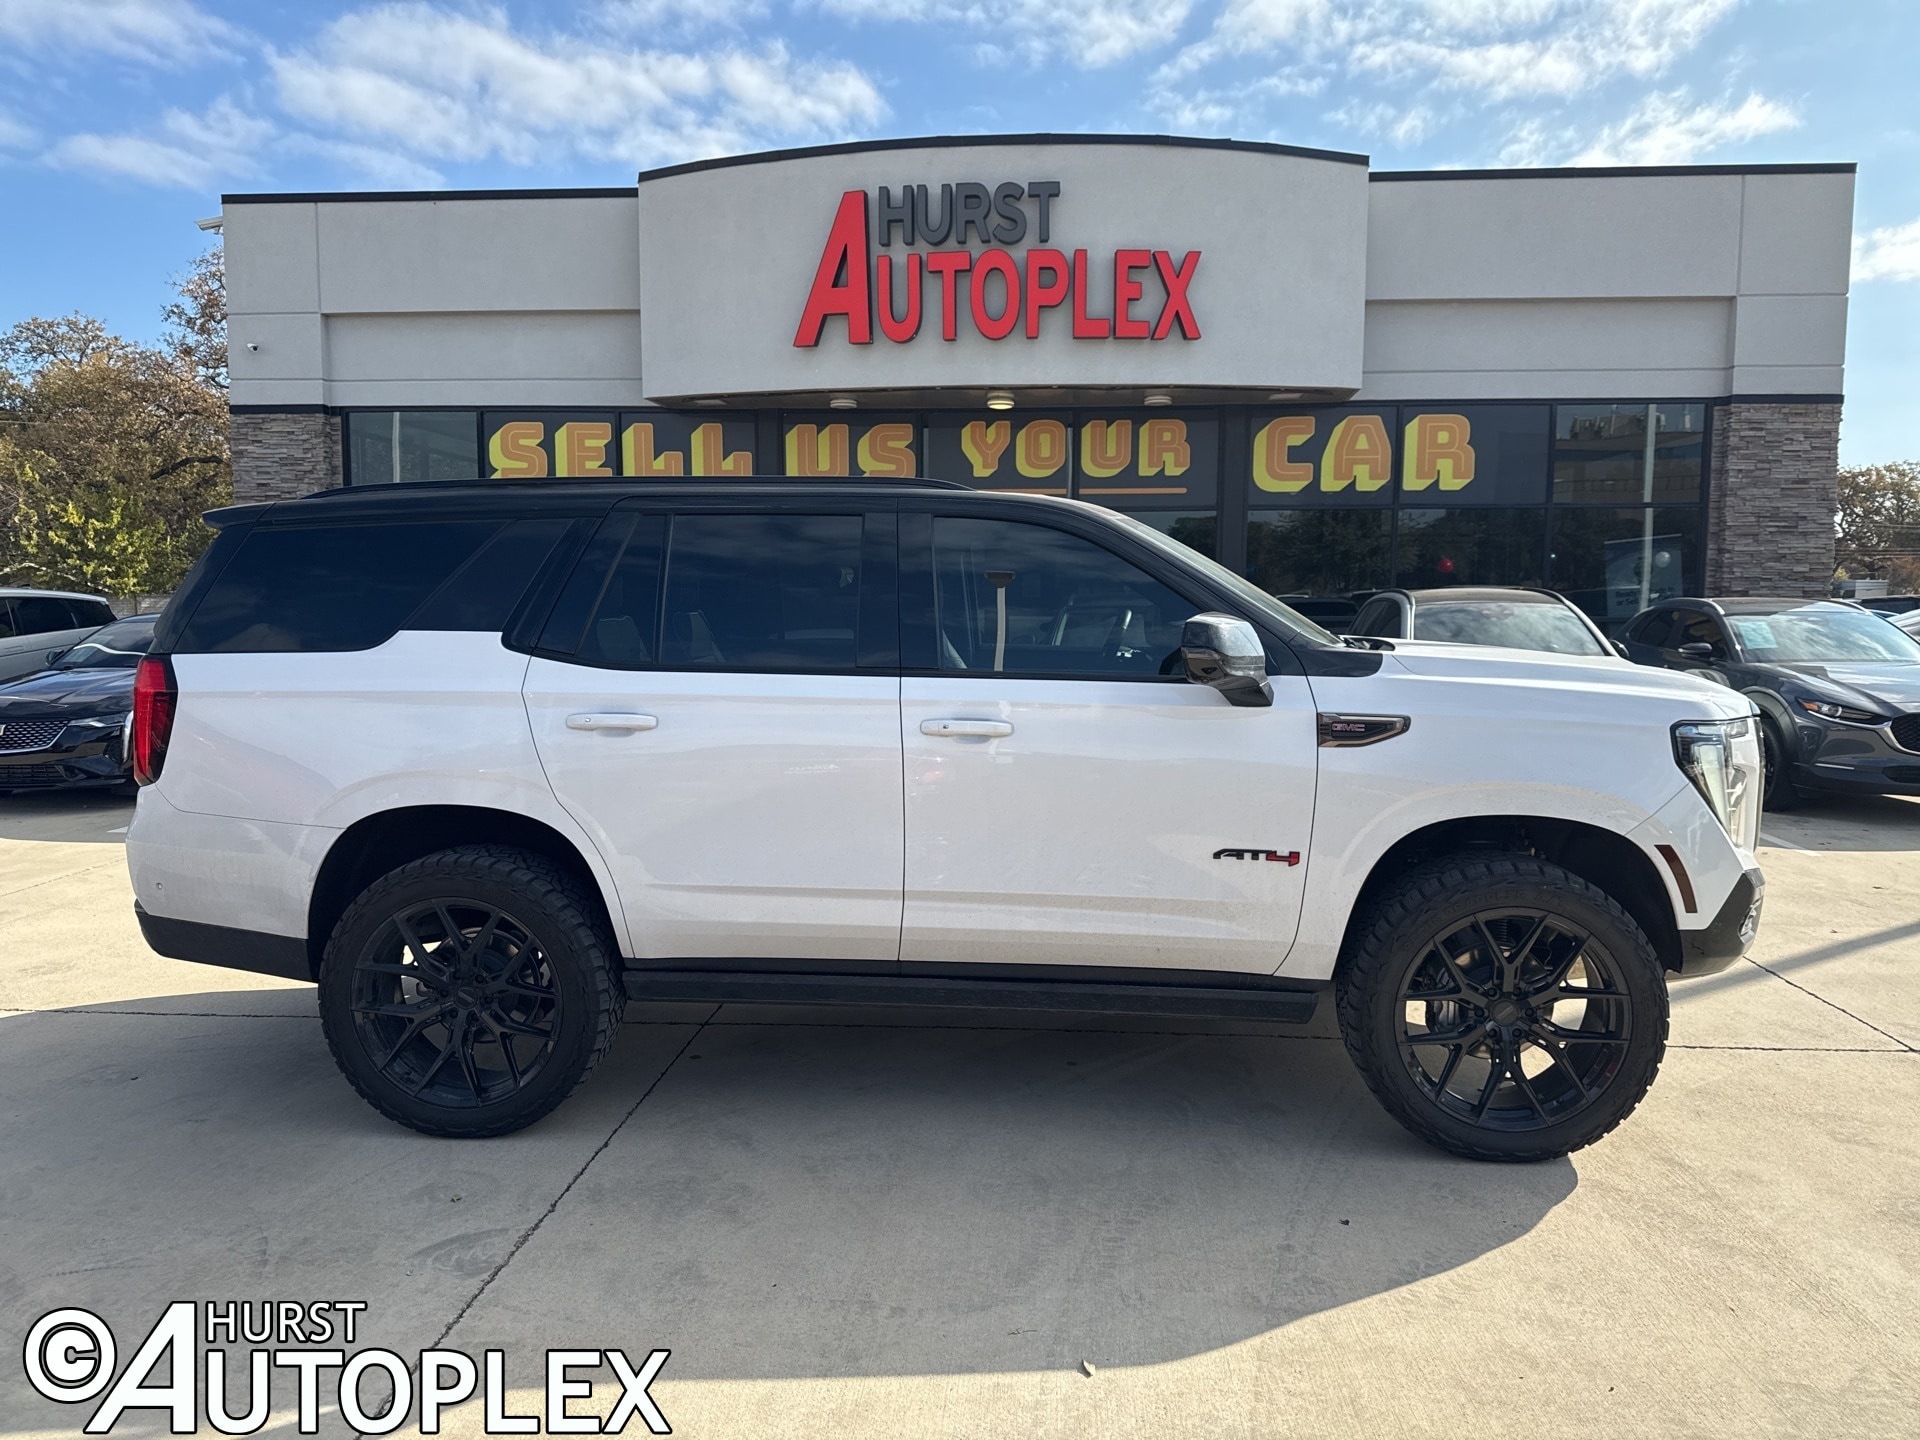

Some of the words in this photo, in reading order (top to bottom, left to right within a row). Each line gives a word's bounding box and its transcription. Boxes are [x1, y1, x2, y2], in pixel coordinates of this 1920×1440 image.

[878, 181, 1061, 247] HURST
[793, 190, 1202, 347] AUTOPLEX
[488, 421, 753, 478] SELL
[785, 423, 917, 477] US
[961, 419, 1190, 478] YOUR
[1252, 414, 1475, 493] CAR
[1332, 723, 1366, 732] GMC
[1213, 849, 1300, 867] AT4
